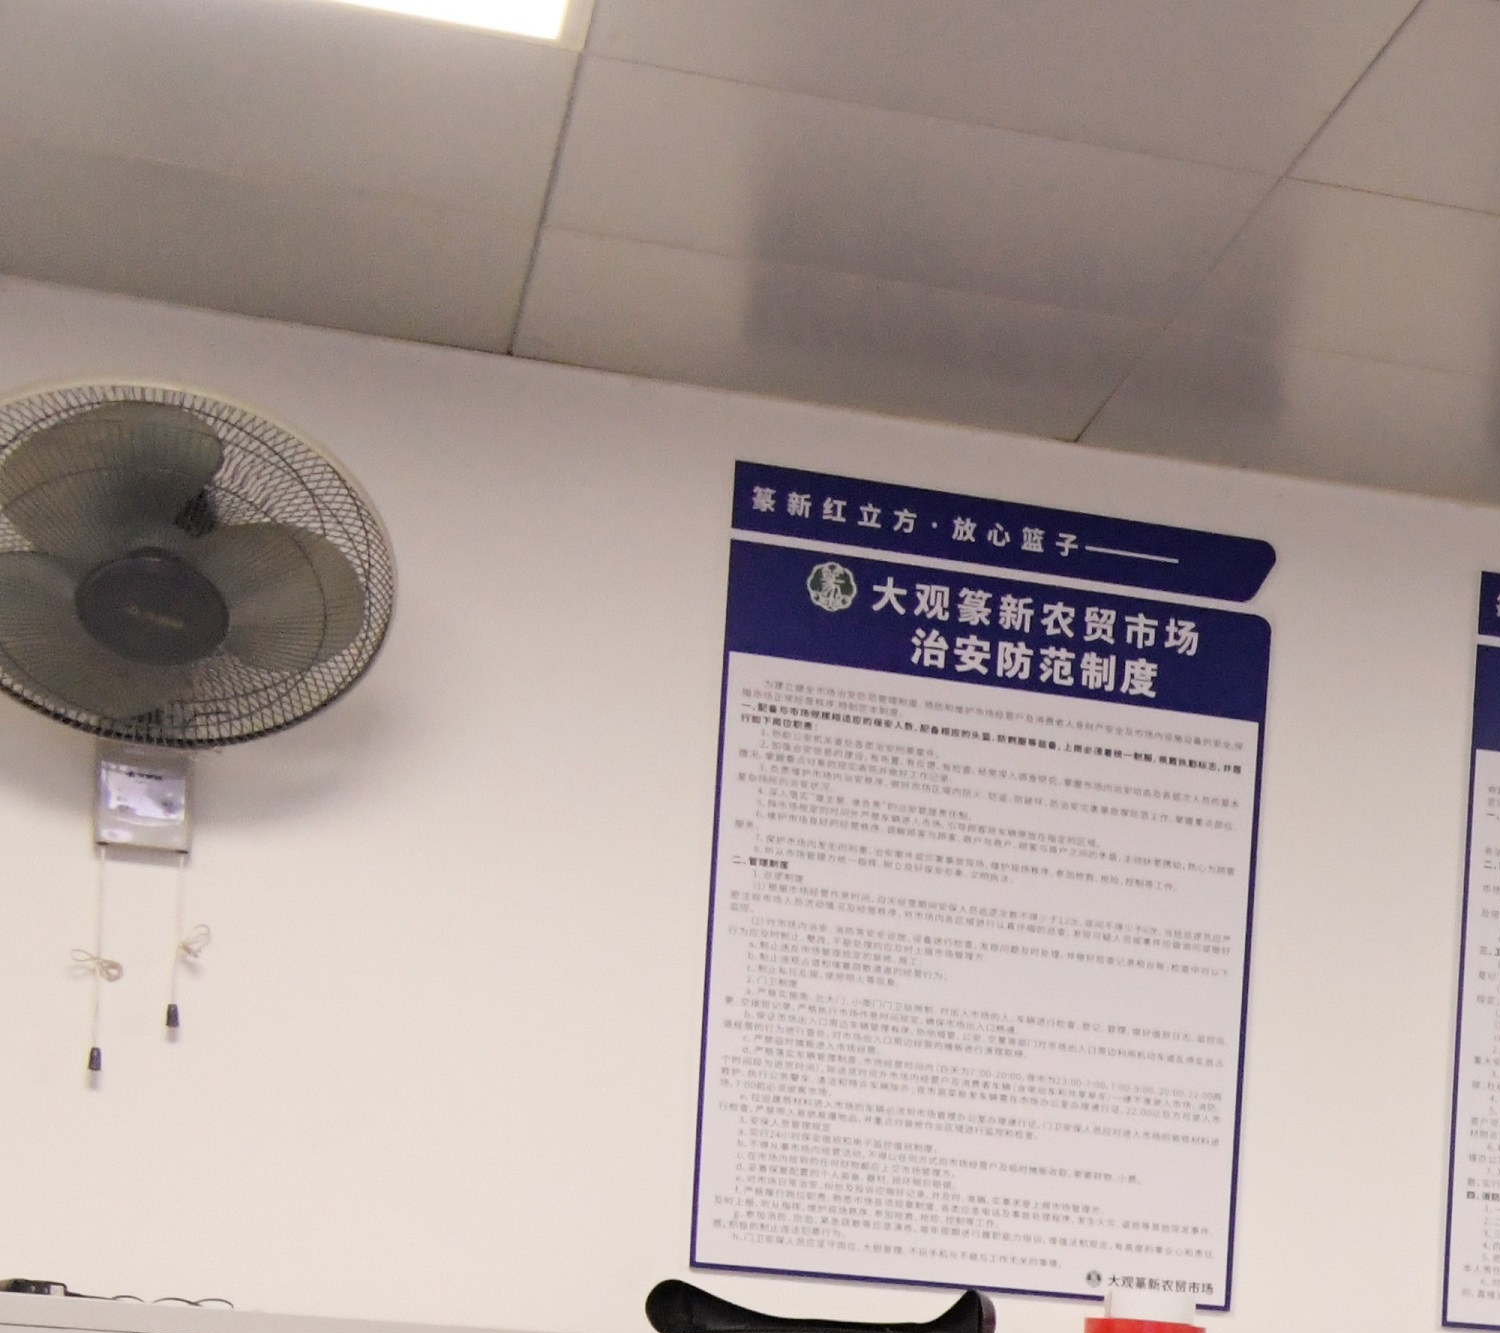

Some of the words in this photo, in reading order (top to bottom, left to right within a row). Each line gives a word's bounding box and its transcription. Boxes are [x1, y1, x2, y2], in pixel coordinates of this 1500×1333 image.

[751, 485, 1080, 557] 篆新红立方·放心篮子
[871, 576, 1201, 657] 大观篆新农贸市场
[910, 628, 1159, 699] 治安防范制度
[1107, 1273, 1215, 1295] 大观篆新农贸市场
